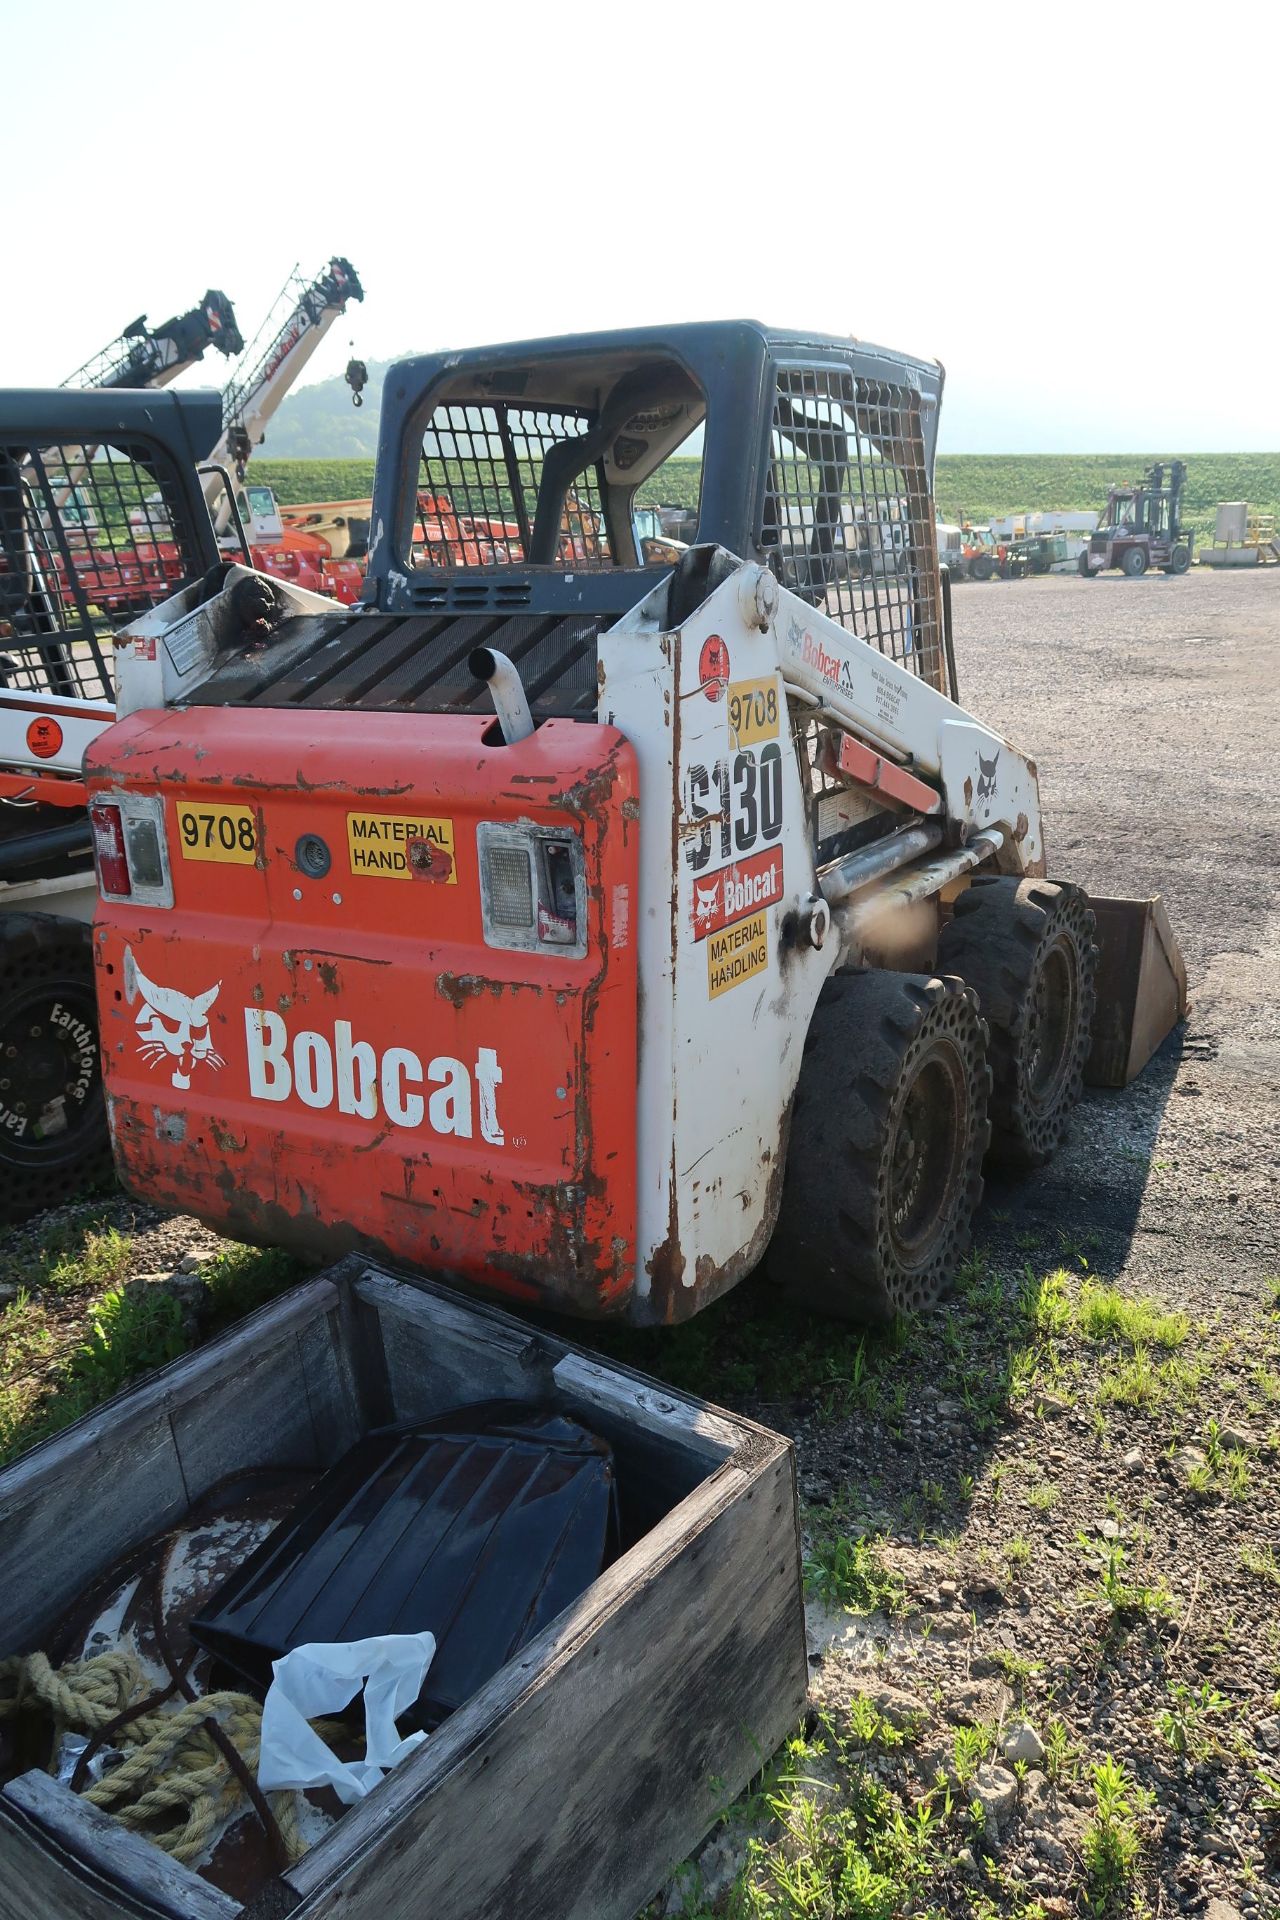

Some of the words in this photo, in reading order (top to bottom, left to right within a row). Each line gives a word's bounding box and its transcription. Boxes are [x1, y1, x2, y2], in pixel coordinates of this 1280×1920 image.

[802, 632, 841, 683] Bobcat
[822, 675, 854, 700] ENTRPRISES
[730, 688, 777, 732] 9708
[683, 743, 783, 872] S130
[181, 813, 255, 852] 9708
[352, 820, 449, 845] MATERIAL
[354, 849, 406, 871] HAND
[724, 863, 776, 917] Bobcat
[711, 920, 764, 961] MATERIAL
[711, 945, 766, 990] HANDLING
[50, 1003, 96, 1098] EarthForce
[244, 1006, 505, 1146] Bobcat
